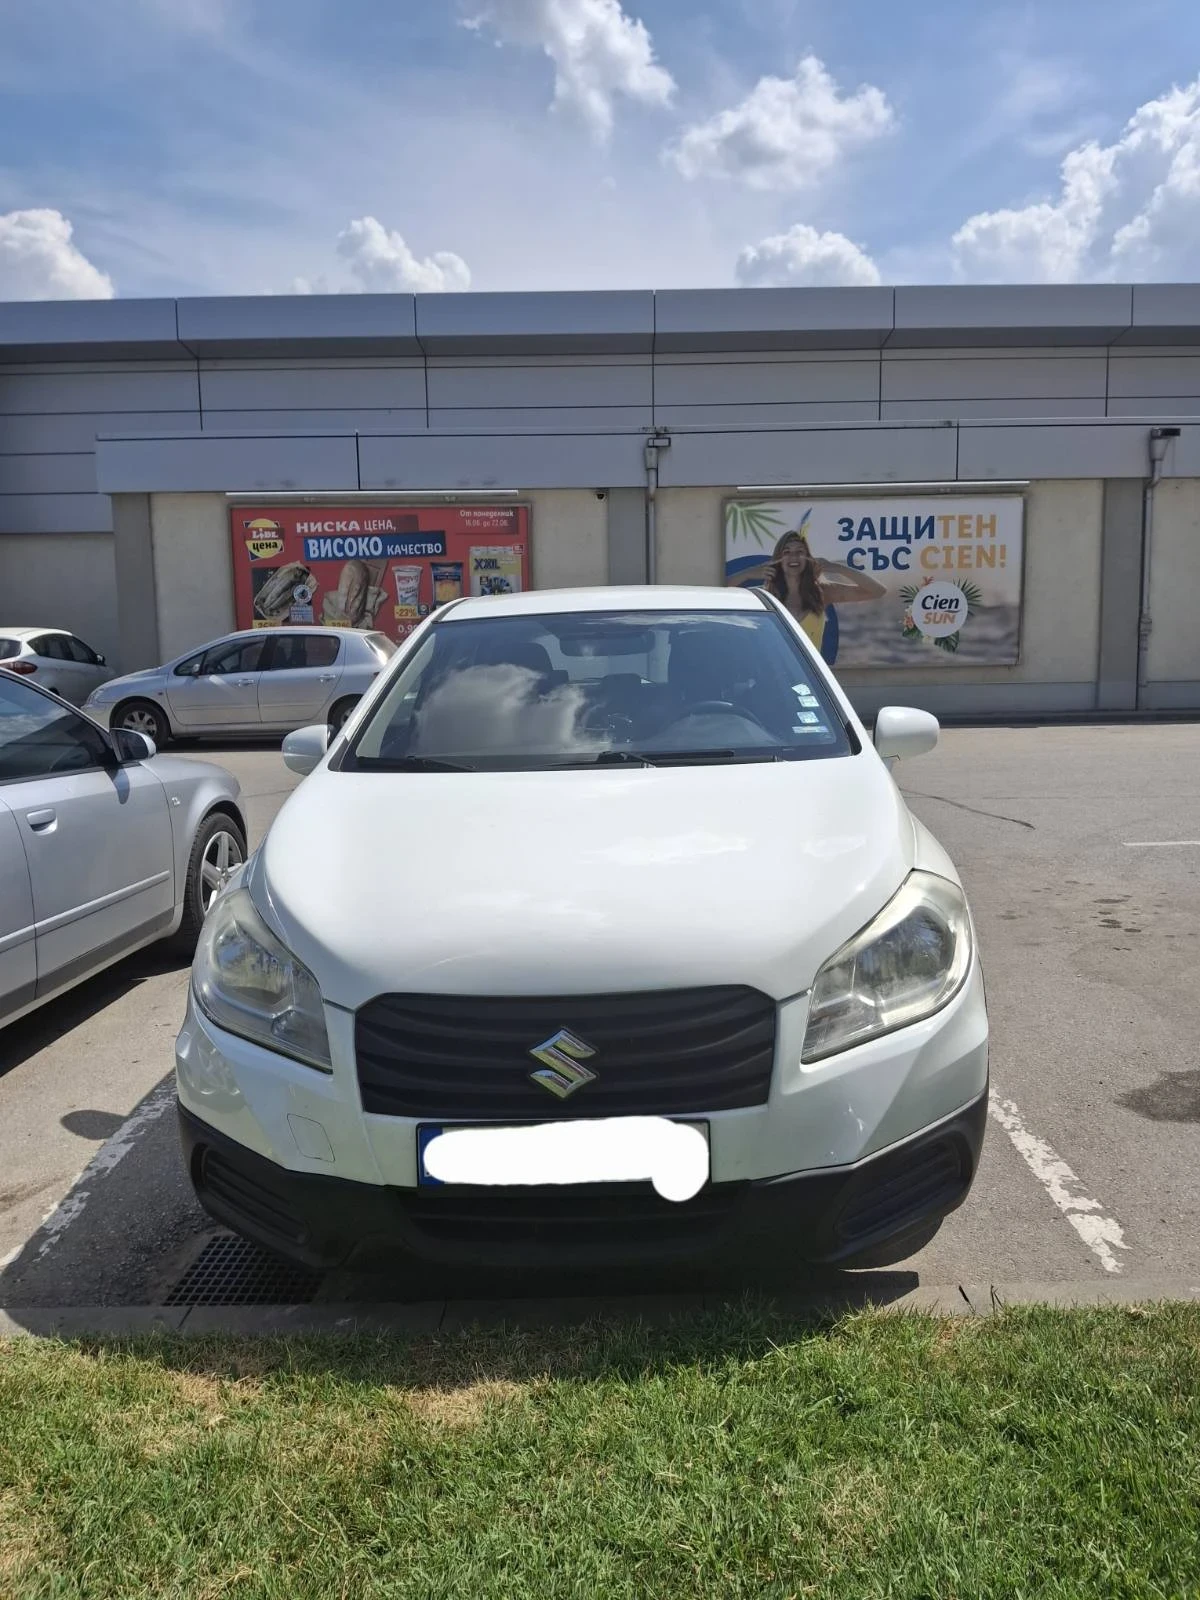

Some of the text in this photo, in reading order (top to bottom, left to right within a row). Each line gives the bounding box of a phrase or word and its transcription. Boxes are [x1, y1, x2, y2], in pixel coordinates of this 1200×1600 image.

[296, 519, 397, 534] НИСКА ЦЕНА,
[838, 514, 997, 544] ЗАЩИТЕН
[252, 541, 278, 552] цена
[307, 536, 442, 559] ВИСОКО КАЧЕСТВО
[846, 544, 1006, 571] СЪС CIEN!
[921, 594, 960, 612] Cien
[922, 611, 956, 625] SUN
